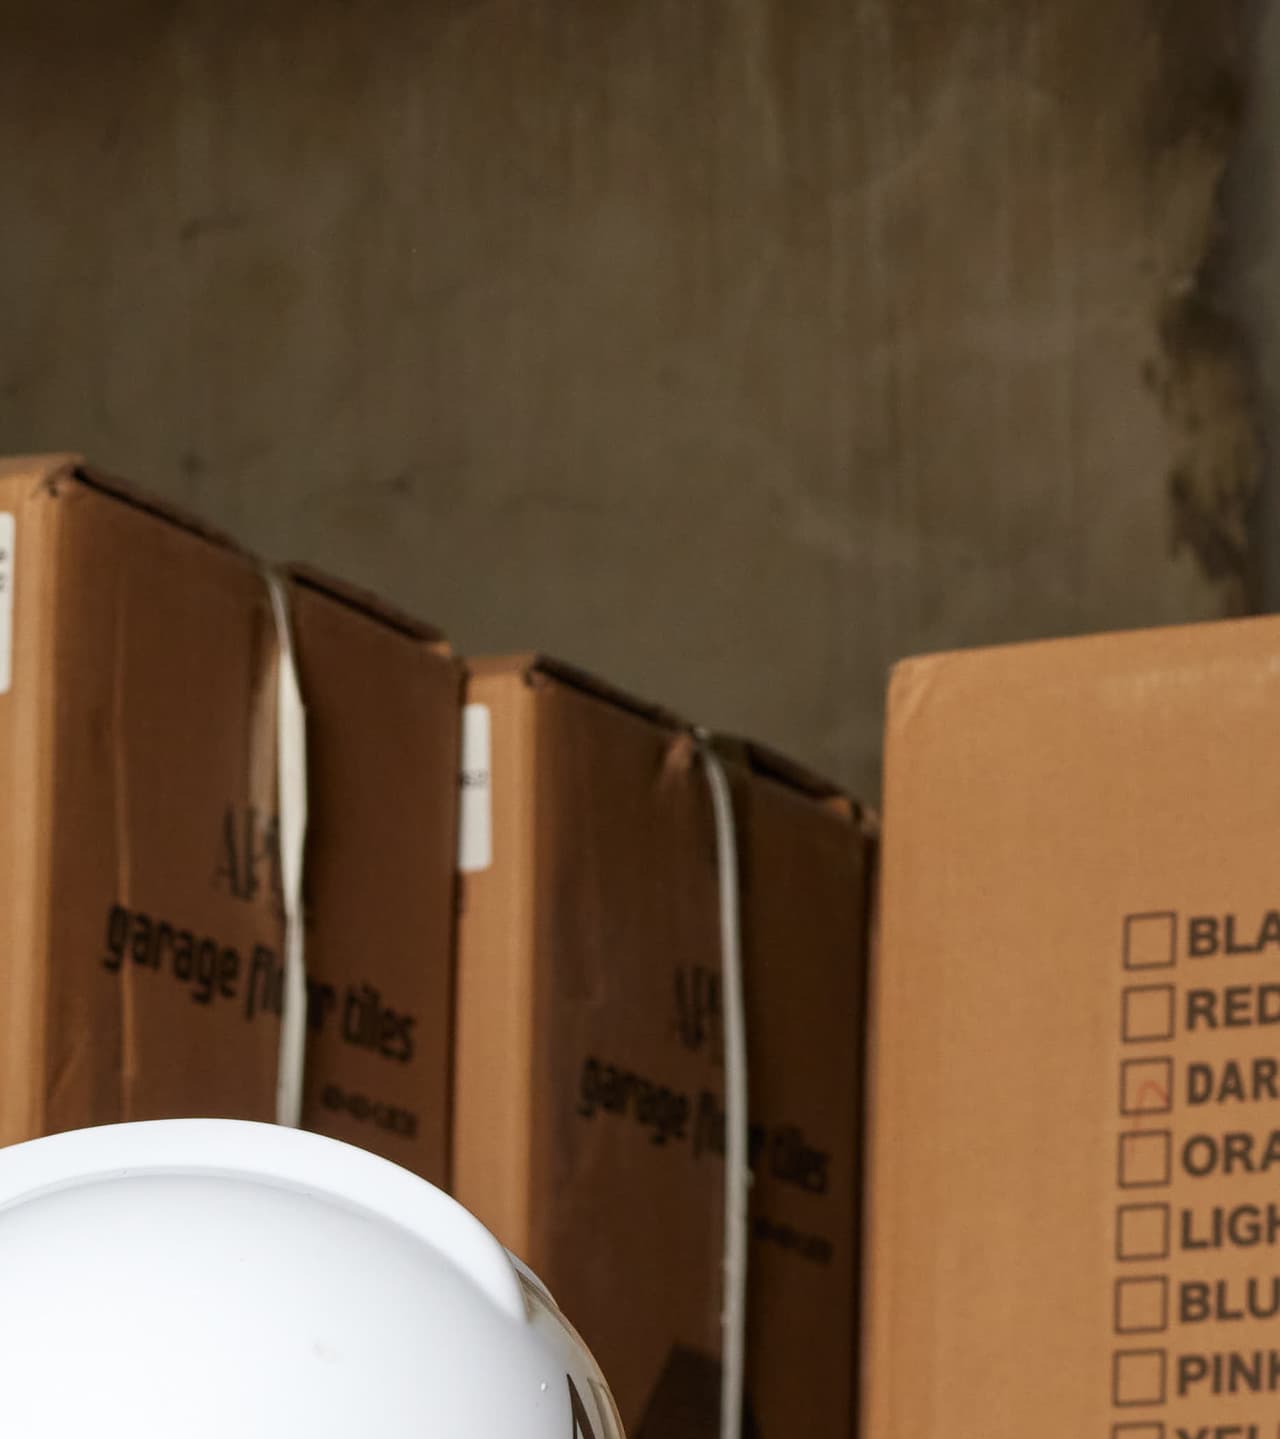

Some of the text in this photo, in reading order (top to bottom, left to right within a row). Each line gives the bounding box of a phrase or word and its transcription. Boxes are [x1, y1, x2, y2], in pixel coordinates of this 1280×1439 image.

[101, 905, 240, 1005] garage
[342, 978, 417, 1063] tiles
[1185, 984, 1280, 1032] RED
